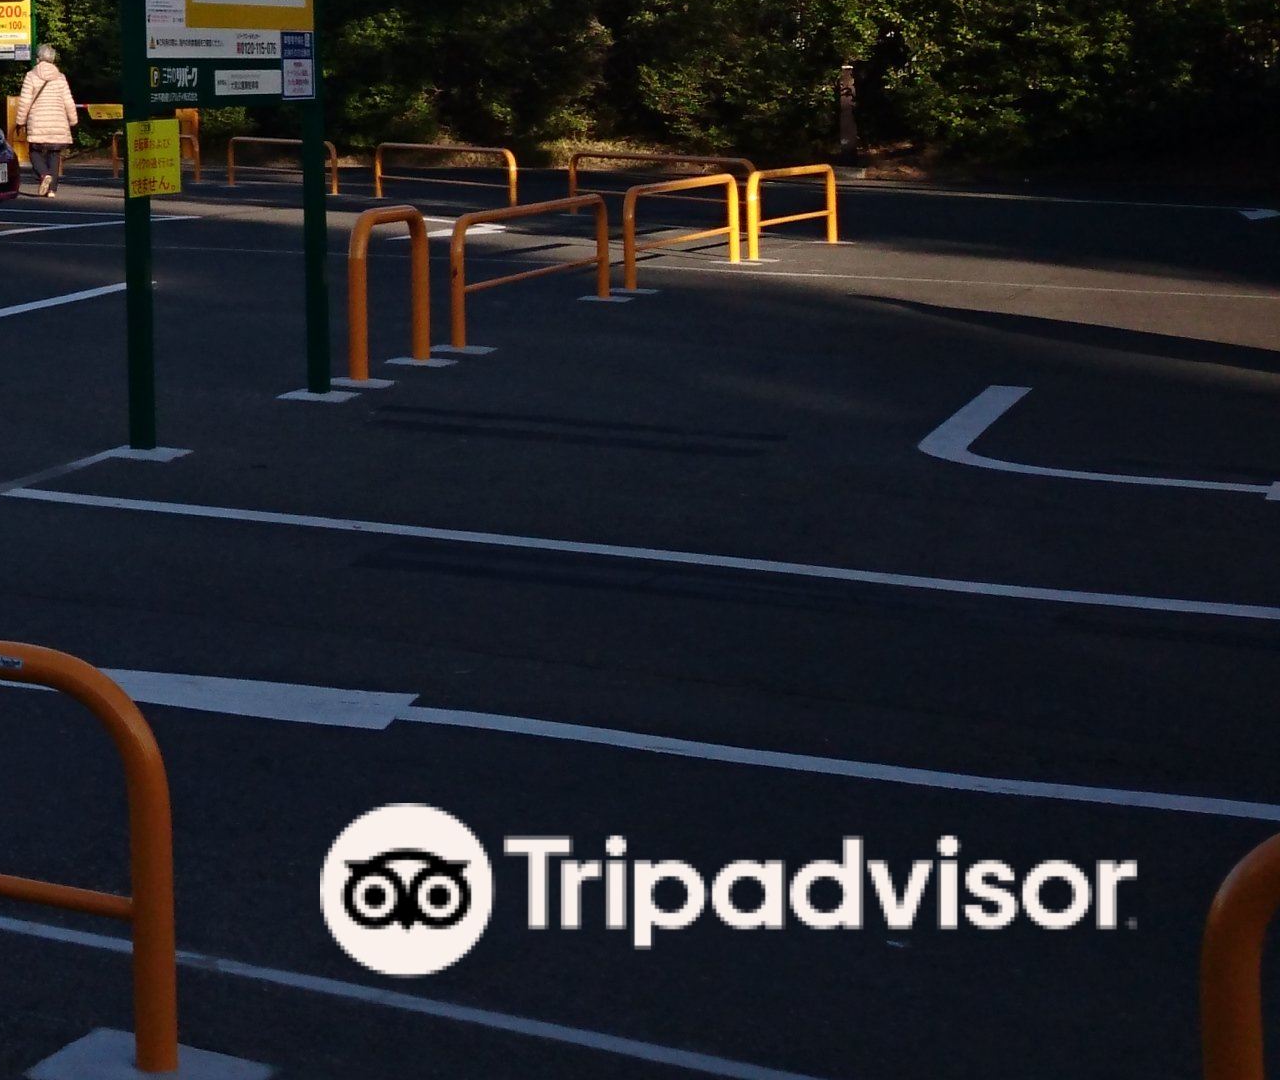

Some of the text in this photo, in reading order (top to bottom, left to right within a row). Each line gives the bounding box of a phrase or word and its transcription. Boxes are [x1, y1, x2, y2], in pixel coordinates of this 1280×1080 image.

[162, 66, 198, 88] 三井のリパーク
[131, 176, 176, 195] できません。
